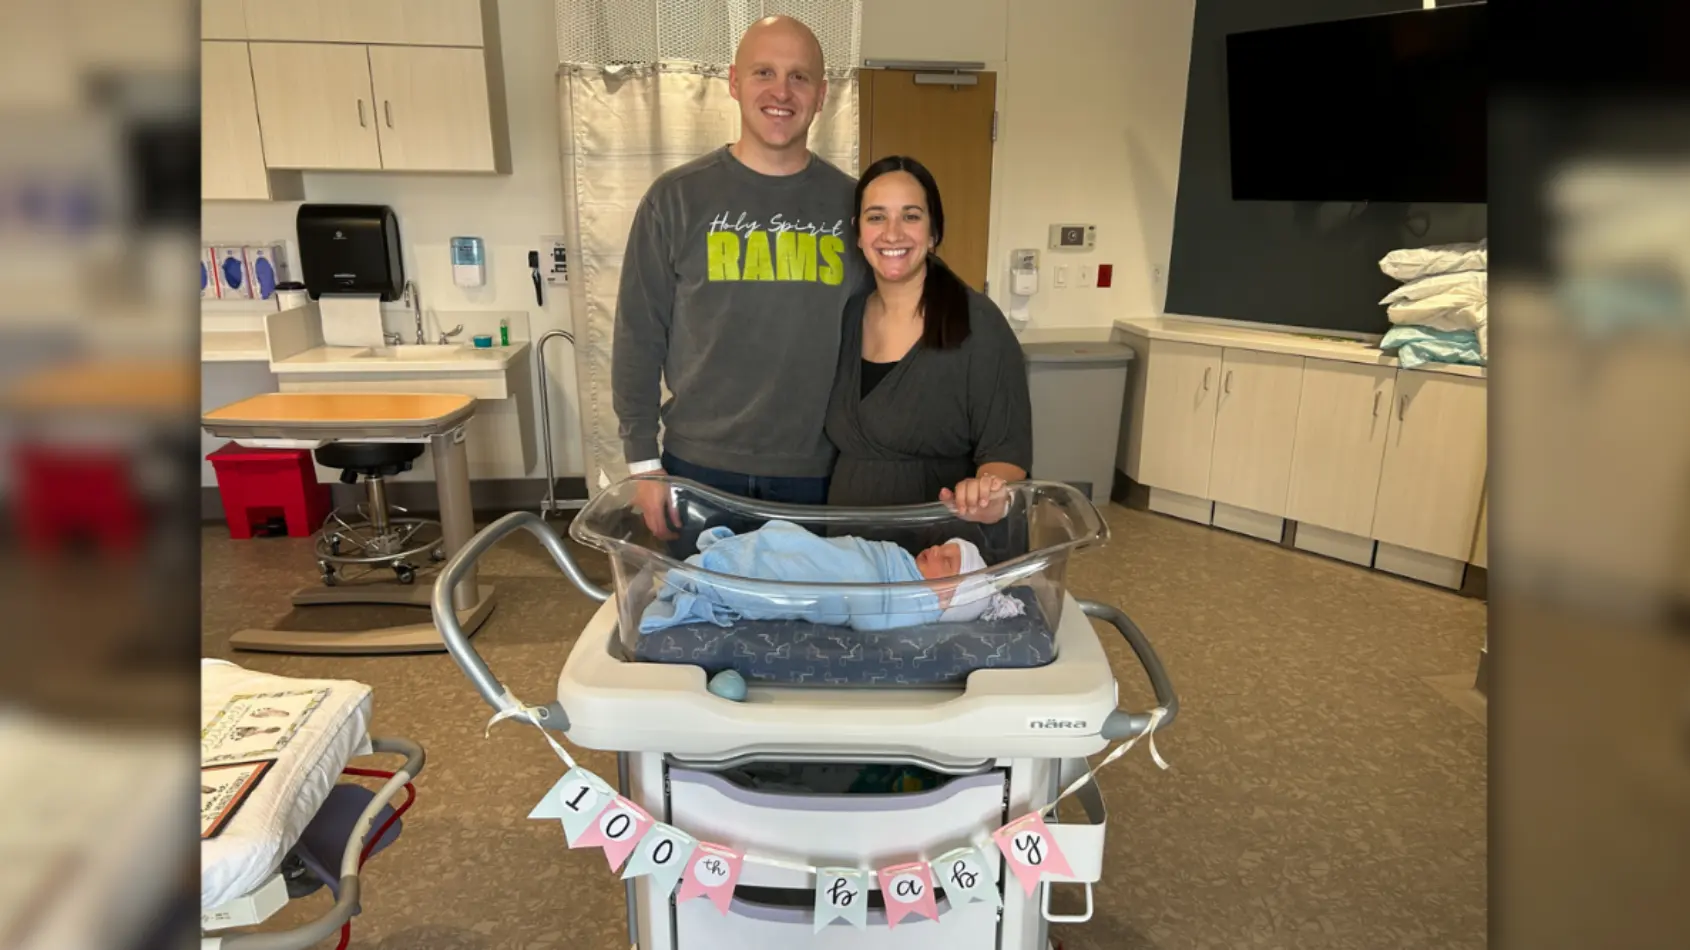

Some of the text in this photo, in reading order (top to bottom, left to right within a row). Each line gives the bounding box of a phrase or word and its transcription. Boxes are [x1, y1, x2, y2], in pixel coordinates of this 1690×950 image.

[709, 211, 845, 240] Holy Spirit
[706, 230, 845, 286] RAMS
